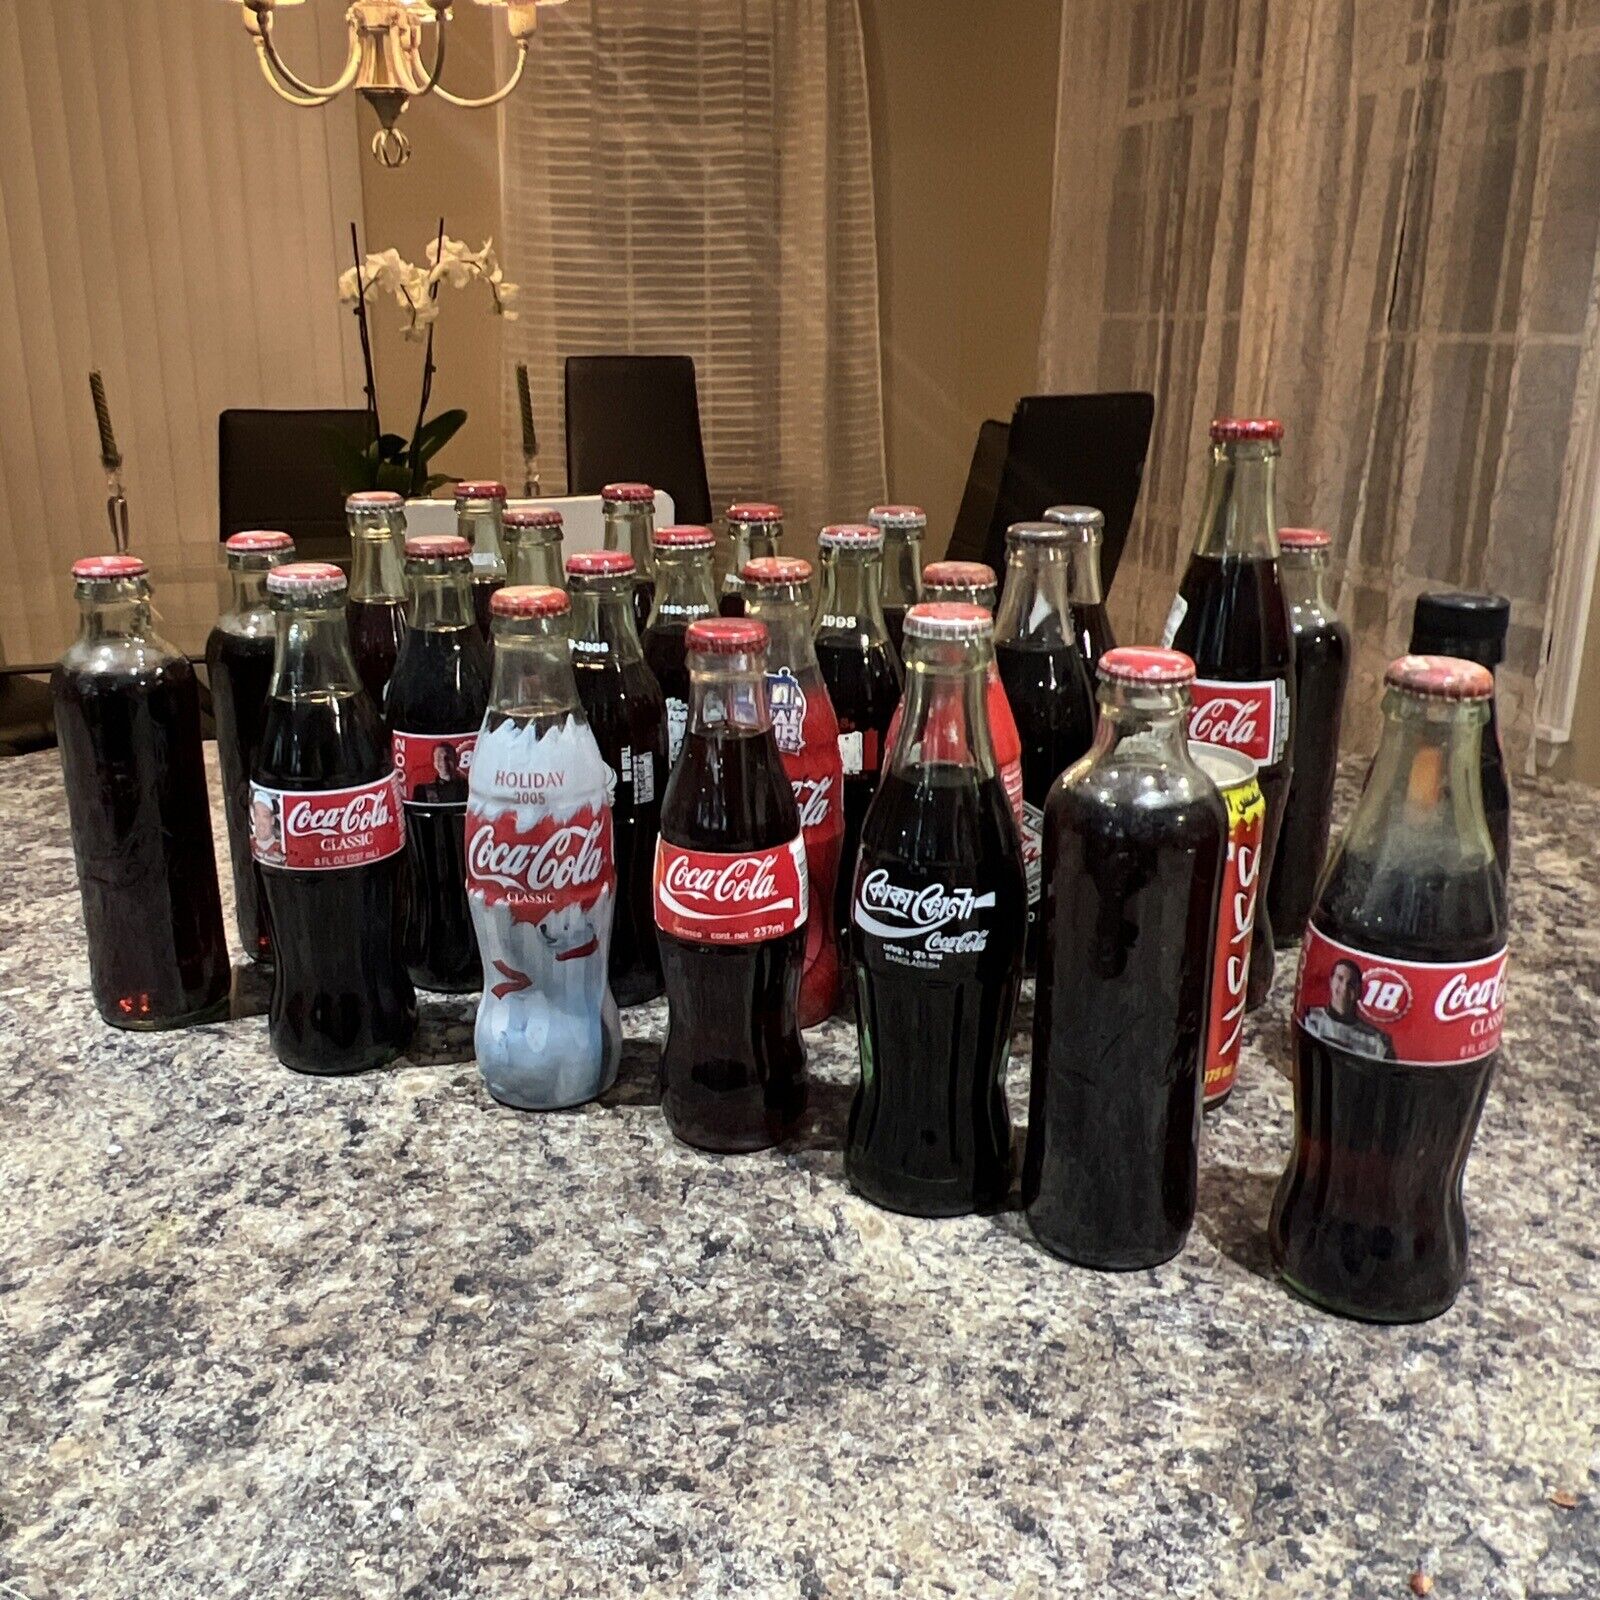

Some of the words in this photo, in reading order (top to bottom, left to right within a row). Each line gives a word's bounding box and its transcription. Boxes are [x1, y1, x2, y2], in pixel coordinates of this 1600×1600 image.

[1189, 698, 1262, 745] -Cola
[494, 770, 566, 789] HOLIDAY
[287, 788, 390, 837] Coca-Cola
[515, 792, 546, 805] 2005
[320, 831, 374, 851] CLASSIC
[468, 816, 605, 892] Coca-Cola
[666, 853, 778, 902] Coca-Cola
[506, 892, 556, 904] CLASSIC
[924, 929, 990, 954] Coca-Cola
[1362, 980, 1404, 1012] 18
